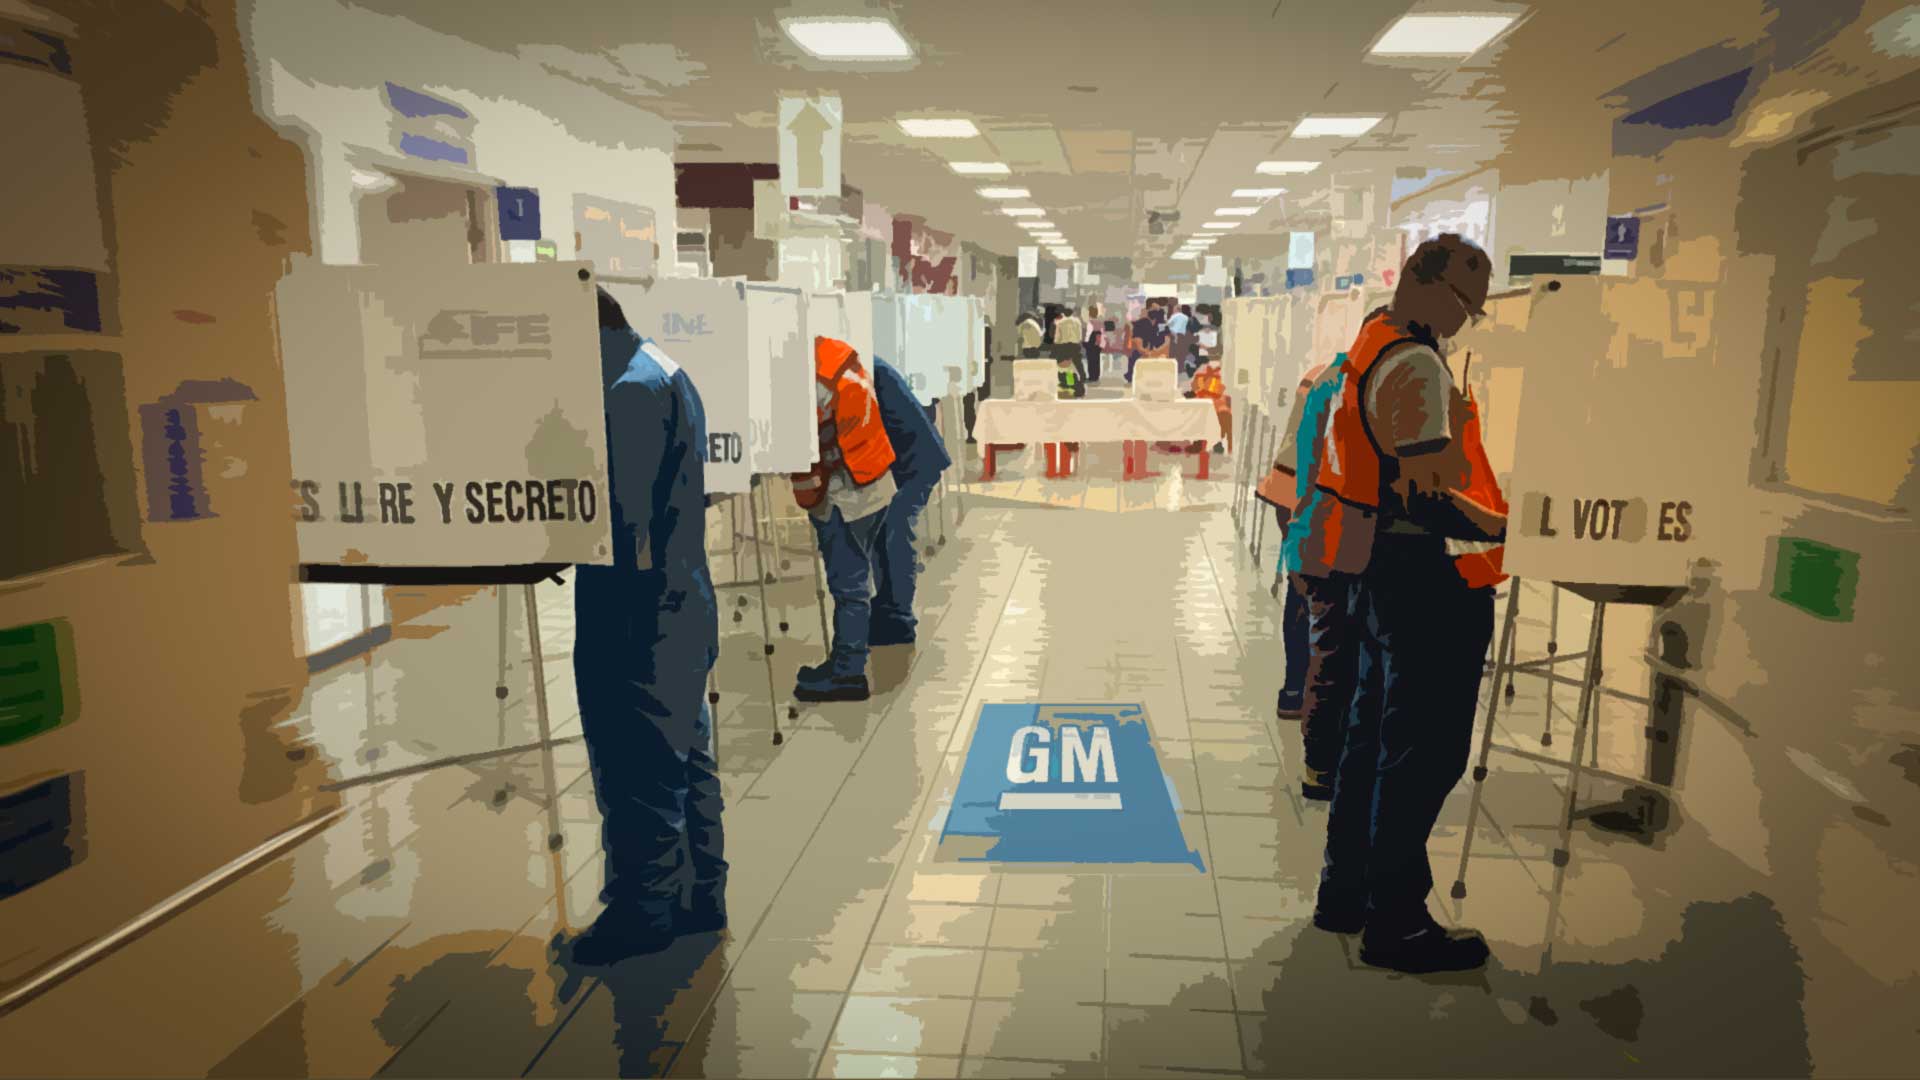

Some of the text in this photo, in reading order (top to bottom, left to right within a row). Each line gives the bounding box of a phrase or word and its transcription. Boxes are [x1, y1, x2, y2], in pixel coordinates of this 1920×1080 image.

[708, 432, 742, 464] ETO
[433, 482, 453, 524] Y
[466, 479, 597, 524] SECRETO
[1573, 498, 1648, 543] VOT
[1657, 501, 1692, 542] ES
[1006, 725, 1119, 784] GM
